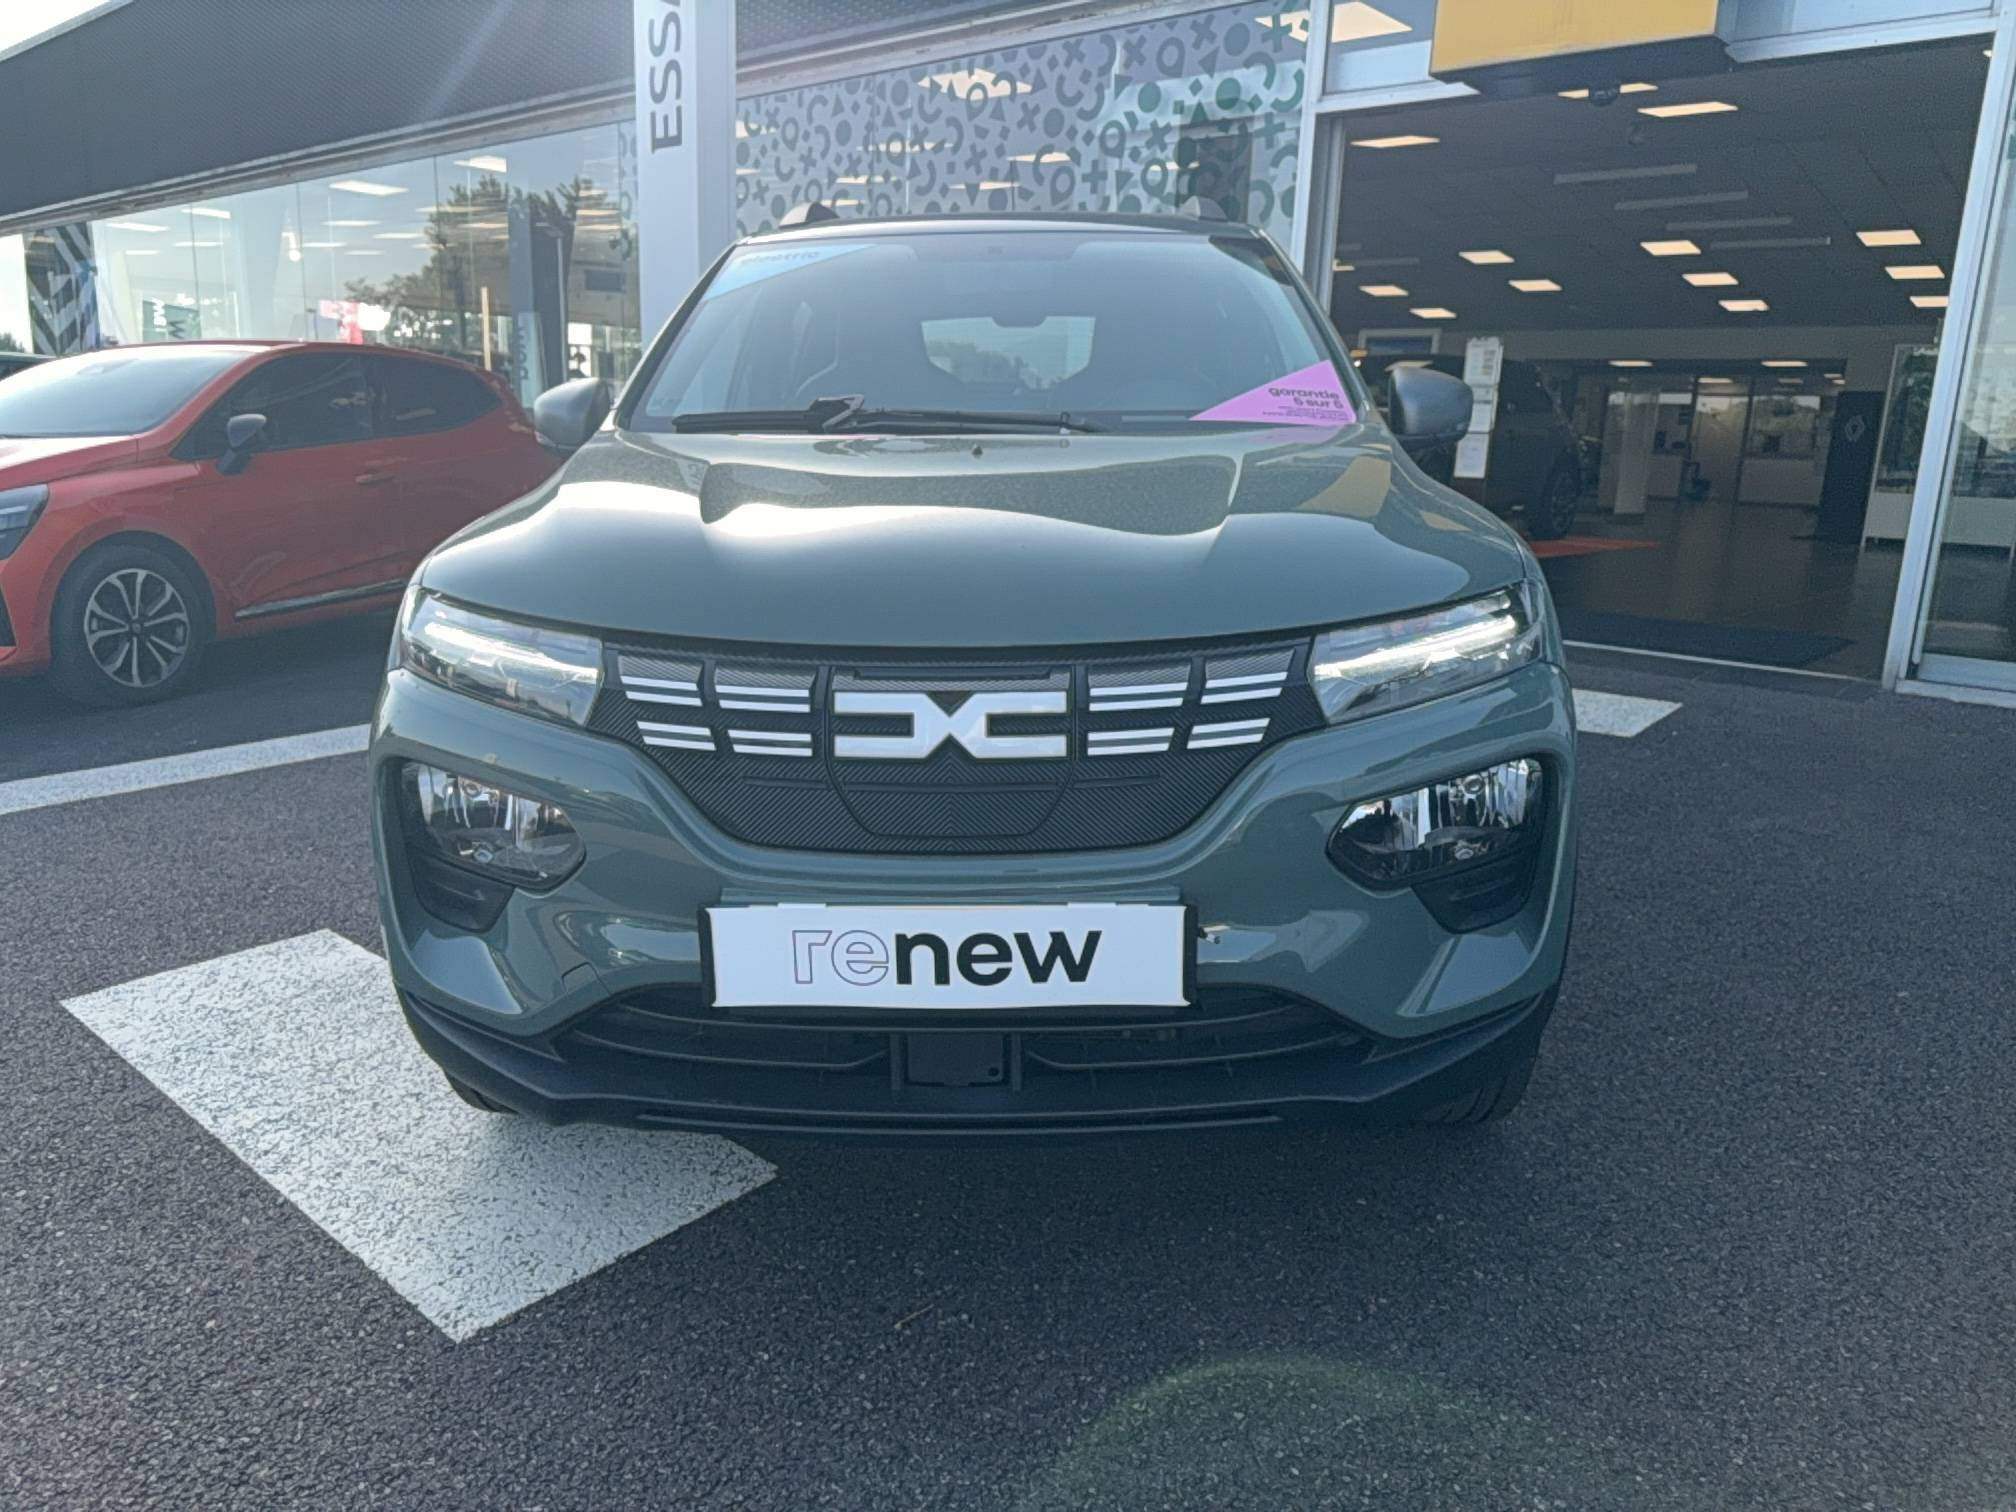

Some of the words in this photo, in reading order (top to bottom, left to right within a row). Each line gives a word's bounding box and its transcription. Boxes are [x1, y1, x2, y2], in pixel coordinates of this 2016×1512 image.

[648, 0, 683, 154] ESS
[1268, 387, 1340, 400] garantie
[1305, 399, 1330, 408] sur
[792, 929, 1102, 986] renew
